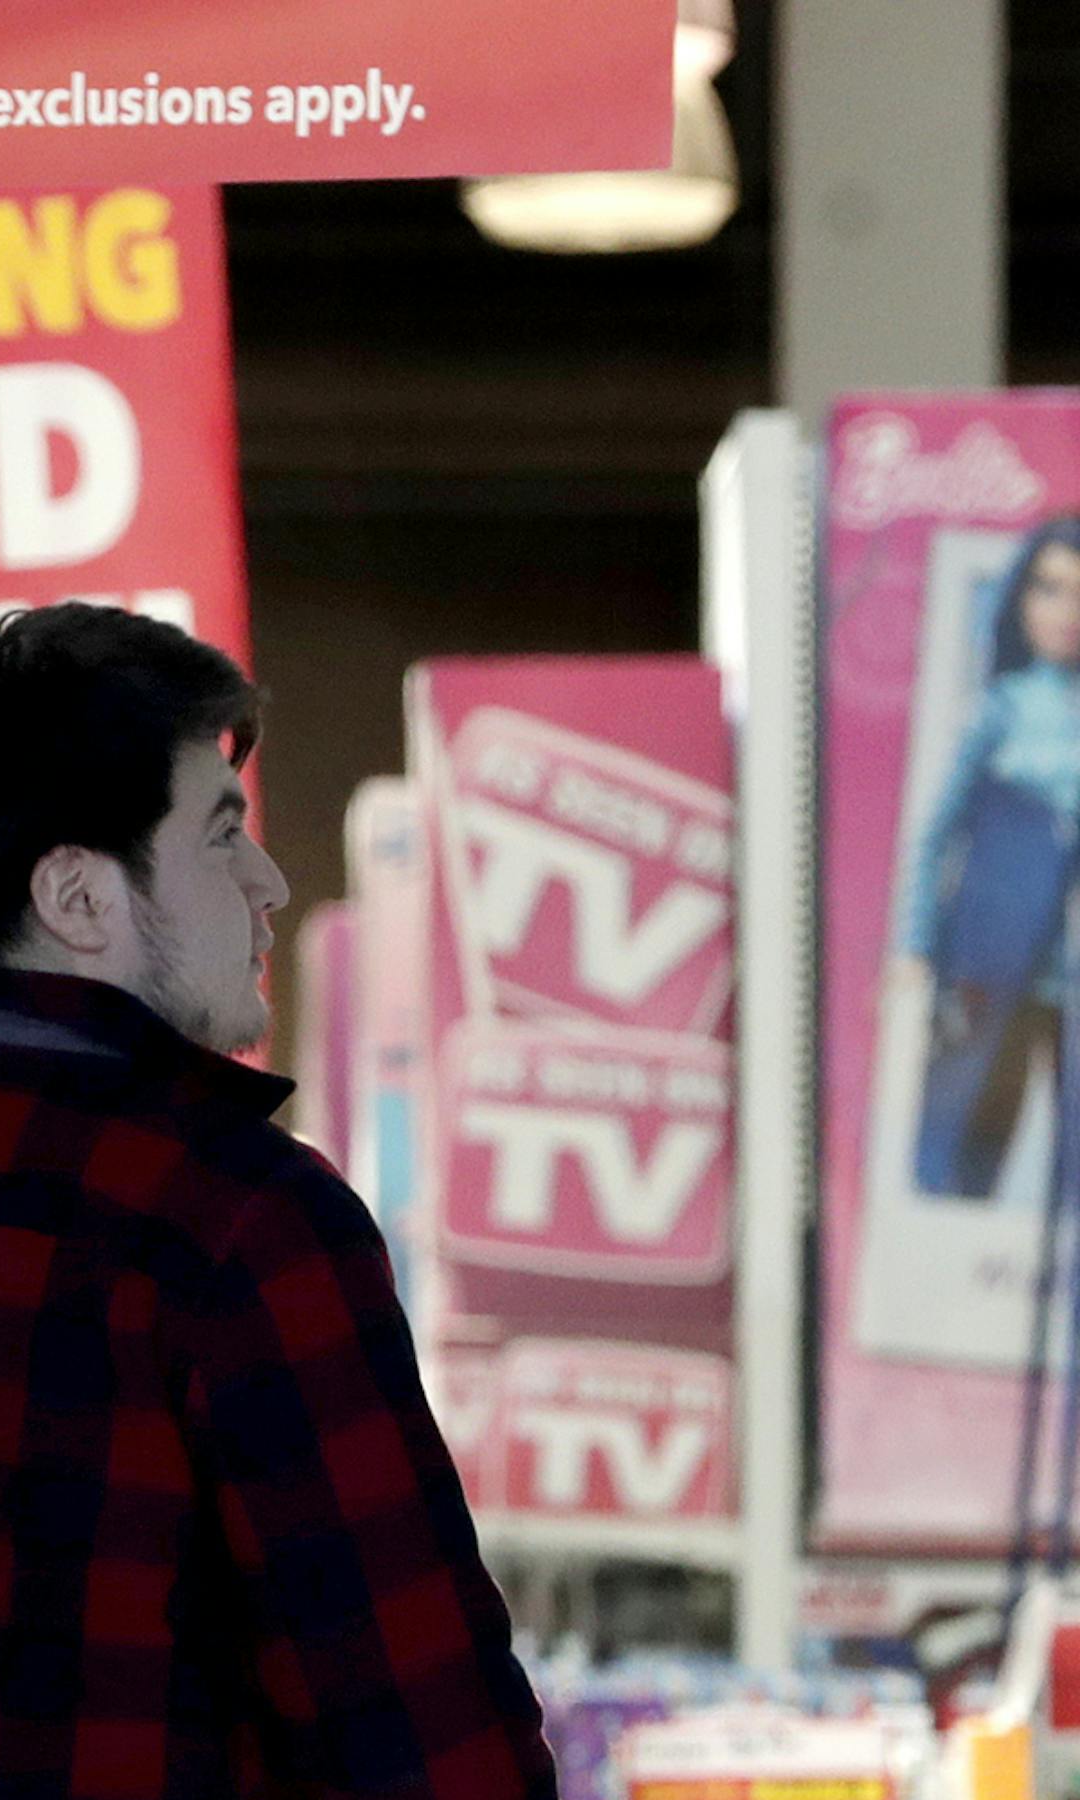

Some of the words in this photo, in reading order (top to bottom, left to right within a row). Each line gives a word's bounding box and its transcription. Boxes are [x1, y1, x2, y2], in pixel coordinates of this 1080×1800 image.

[264, 68, 426, 137] apply.
[458, 803, 730, 1005] TV
[461, 1103, 721, 1246] TV
[515, 1410, 708, 1506] TV
